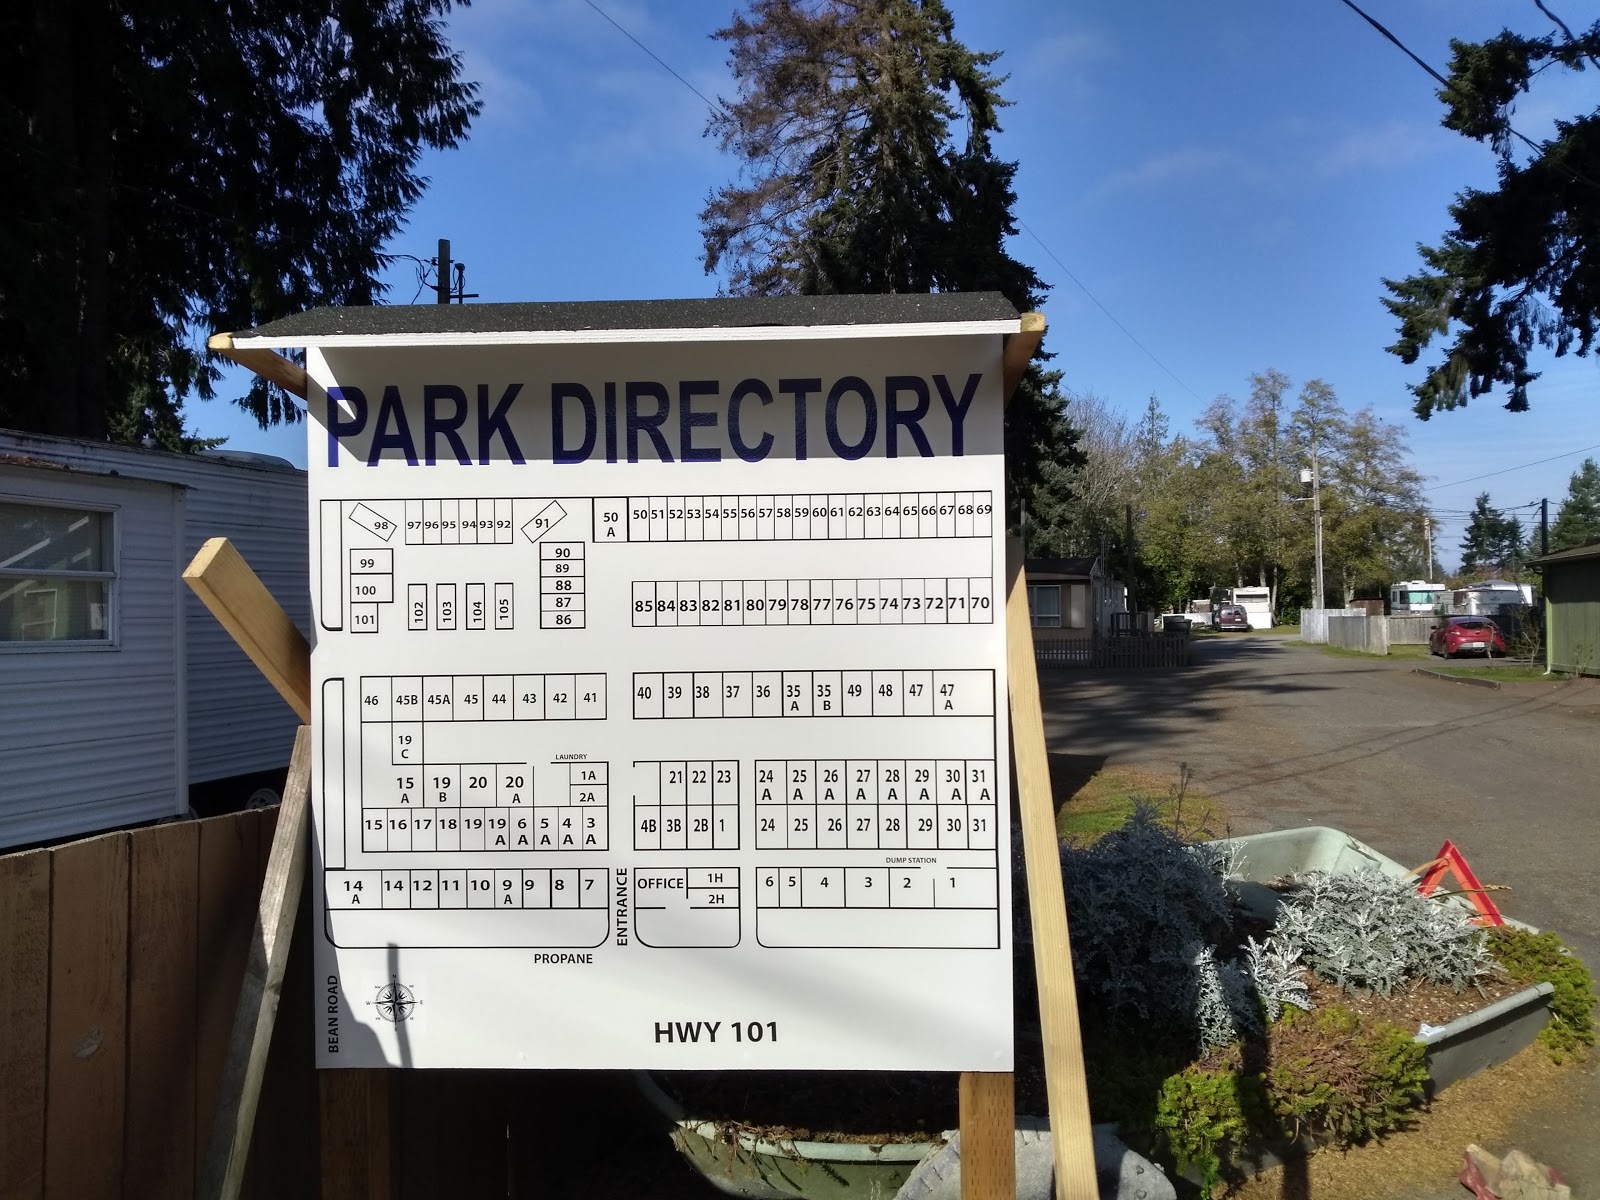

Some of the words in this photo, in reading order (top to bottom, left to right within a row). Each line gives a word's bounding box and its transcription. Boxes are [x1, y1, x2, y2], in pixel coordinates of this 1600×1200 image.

[326, 382, 528, 467] PARK
[550, 372, 983, 464] DIRECTORY
[602, 511, 619, 523] 50
[632, 509, 648, 520] 50
[650, 508, 666, 519] 51
[668, 508, 684, 519] 52
[686, 508, 702, 519] 53
[704, 508, 720, 519] 54
[722, 507, 738, 518] 55
[740, 507, 756, 518] 56
[758, 507, 773, 518] 57
[776, 507, 792, 518] 58
[794, 506, 810, 517] 59
[812, 506, 828, 517] 60
[830, 506, 845, 517] 61
[848, 506, 864, 517] 62
[866, 505, 881, 516] 63
[884, 505, 900, 516] 64
[902, 505, 918, 516] 65
[920, 505, 937, 516] 66
[939, 504, 955, 515] 67
[957, 504, 974, 515] 68
[976, 504, 992, 515] 69
[373, 521, 389, 531] 98
[407, 520, 422, 529] 97
[424, 520, 440, 529] 96
[441, 520, 457, 529] 95
[461, 520, 477, 529] 94
[479, 520, 494, 529] 93
[496, 519, 512, 529] 92
[534, 518, 550, 529] 91
[554, 547, 571, 558] 90
[359, 558, 375, 568] 99
[555, 563, 570, 573] 89
[355, 585, 377, 595] 100
[555, 580, 572, 590] 88
[555, 597, 572, 607] 87
[634, 600, 653, 613] 85
[657, 599, 676, 613] 84
[679, 599, 698, 612] 83
[701, 599, 720, 612] 82
[723, 599, 742, 612] 81
[745, 598, 765, 611] 80
[768, 598, 787, 611] 79
[790, 598, 809, 611] 78
[813, 598, 832, 611] 77
[835, 598, 854, 610] 76
[857, 597, 876, 610] 75
[880, 597, 899, 610] 74
[902, 597, 921, 610] 73
[925, 597, 944, 609] 72
[948, 597, 966, 609] 71
[970, 596, 990, 609] 70
[413, 600, 425, 624] 102
[442, 600, 453, 623] 103
[472, 600, 483, 623] 104
[499, 598, 509, 621] 105
[354, 614, 375, 625] 101
[555, 614, 572, 625] 86
[637, 686, 652, 699] 40
[667, 686, 683, 699] 39
[695, 686, 710, 699] 38
[725, 685, 740, 698] 37
[756, 685, 771, 697] 36
[786, 684, 801, 697] 35
[816, 684, 832, 697] 35
[847, 684, 863, 697] 49
[878, 684, 893, 696] 48
[908, 684, 924, 696] 47
[940, 684, 955, 696] 47
[364, 695, 379, 705] 46
[396, 695, 418, 705] 45B
[427, 694, 451, 705] 45A
[463, 694, 479, 704] 45
[491, 693, 507, 704] 44
[522, 693, 537, 703] 43
[552, 693, 568, 703] 42
[583, 692, 597, 703] 41
[790, 700, 799, 711] A
[823, 700, 831, 711] B
[944, 700, 954, 710] A
[398, 735, 412, 745] 19
[581, 770, 596, 780] 1A
[669, 770, 683, 784] 21
[691, 770, 707, 784] 22
[716, 770, 732, 783] 23
[758, 770, 774, 783] 24
[792, 770, 807, 783] 25
[823, 770, 839, 783] 26
[856, 769, 871, 783] 27
[885, 769, 900, 782] 28
[914, 769, 930, 782] 29
[945, 769, 961, 782] 30
[971, 769, 985, 782] 31
[396, 777, 414, 789] 15
[433, 777, 451, 789] 19
[469, 776, 488, 788] 20
[505, 776, 524, 788] 20
[579, 792, 595, 802] 2A
[365, 819, 383, 830] 15
[389, 819, 407, 830] 16
[414, 818, 432, 829] 17
[439, 818, 457, 829] 18
[464, 818, 482, 829] 19
[488, 818, 506, 829] 19
[517, 818, 527, 829] 6
[540, 817, 549, 828] 5
[562, 817, 572, 828] 4
[587, 817, 596, 828] 3
[640, 819, 657, 832] 4B
[666, 819, 682, 832] 3B
[693, 819, 709, 832] 2B
[719, 819, 725, 832] 1
[760, 818, 775, 832] 24
[794, 818, 809, 832] 25
[827, 818, 842, 832] 26
[856, 818, 871, 832] 27
[885, 818, 900, 832] 28
[918, 818, 933, 832] 29
[946, 818, 962, 832] 30
[973, 818, 987, 832] 31
[494, 835, 506, 845] A
[885, 856, 907, 864] DUMP
[908, 856, 937, 864] STATION
[637, 877, 684, 889] OFFICE
[707, 872, 724, 883] 1H
[765, 876, 774, 888] 6
[788, 876, 796, 888] 5
[820, 876, 829, 888] 4
[864, 876, 873, 888] 3
[903, 877, 911, 889] 2
[950, 877, 956, 889] 1
[343, 880, 364, 891] 14
[384, 880, 404, 891] 14
[413, 879, 433, 891] 12
[442, 879, 460, 891] 11
[471, 879, 491, 891] 10
[502, 879, 512, 891] 9
[524, 879, 535, 891] 9
[554, 879, 565, 891] 8
[584, 878, 595, 890] 7
[503, 894, 513, 905] A
[708, 894, 725, 904] 2H
[616, 867, 628, 946] ENTRANCE
[534, 953, 593, 964] PROPANE
[327, 974, 339, 1013] ROAD
[327, 1014, 339, 1053] BEAN
[654, 1021, 722, 1043] HWY
[731, 1021, 779, 1042] 101
